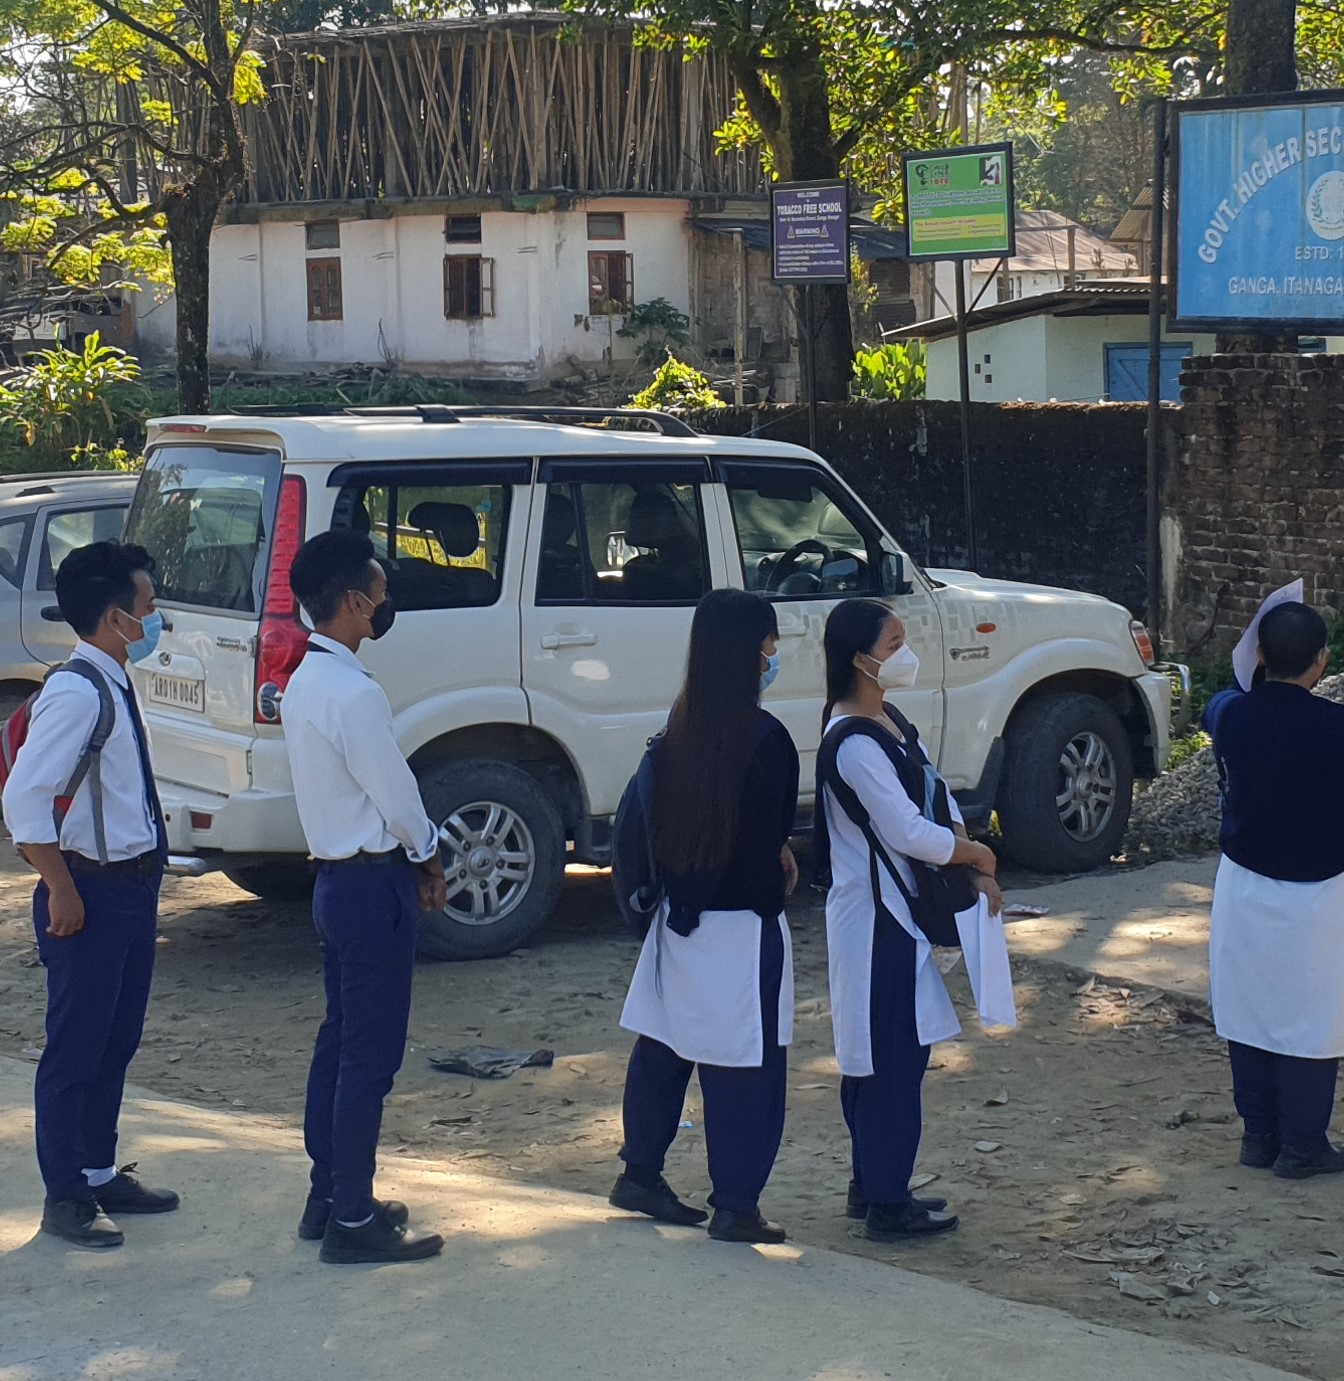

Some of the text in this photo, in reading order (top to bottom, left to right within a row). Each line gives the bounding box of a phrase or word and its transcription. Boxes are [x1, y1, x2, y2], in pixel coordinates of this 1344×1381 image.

[1233, 136, 1302, 206] HIGHER
[777, 201, 842, 215] TOBACCO FREE SCHOOL
